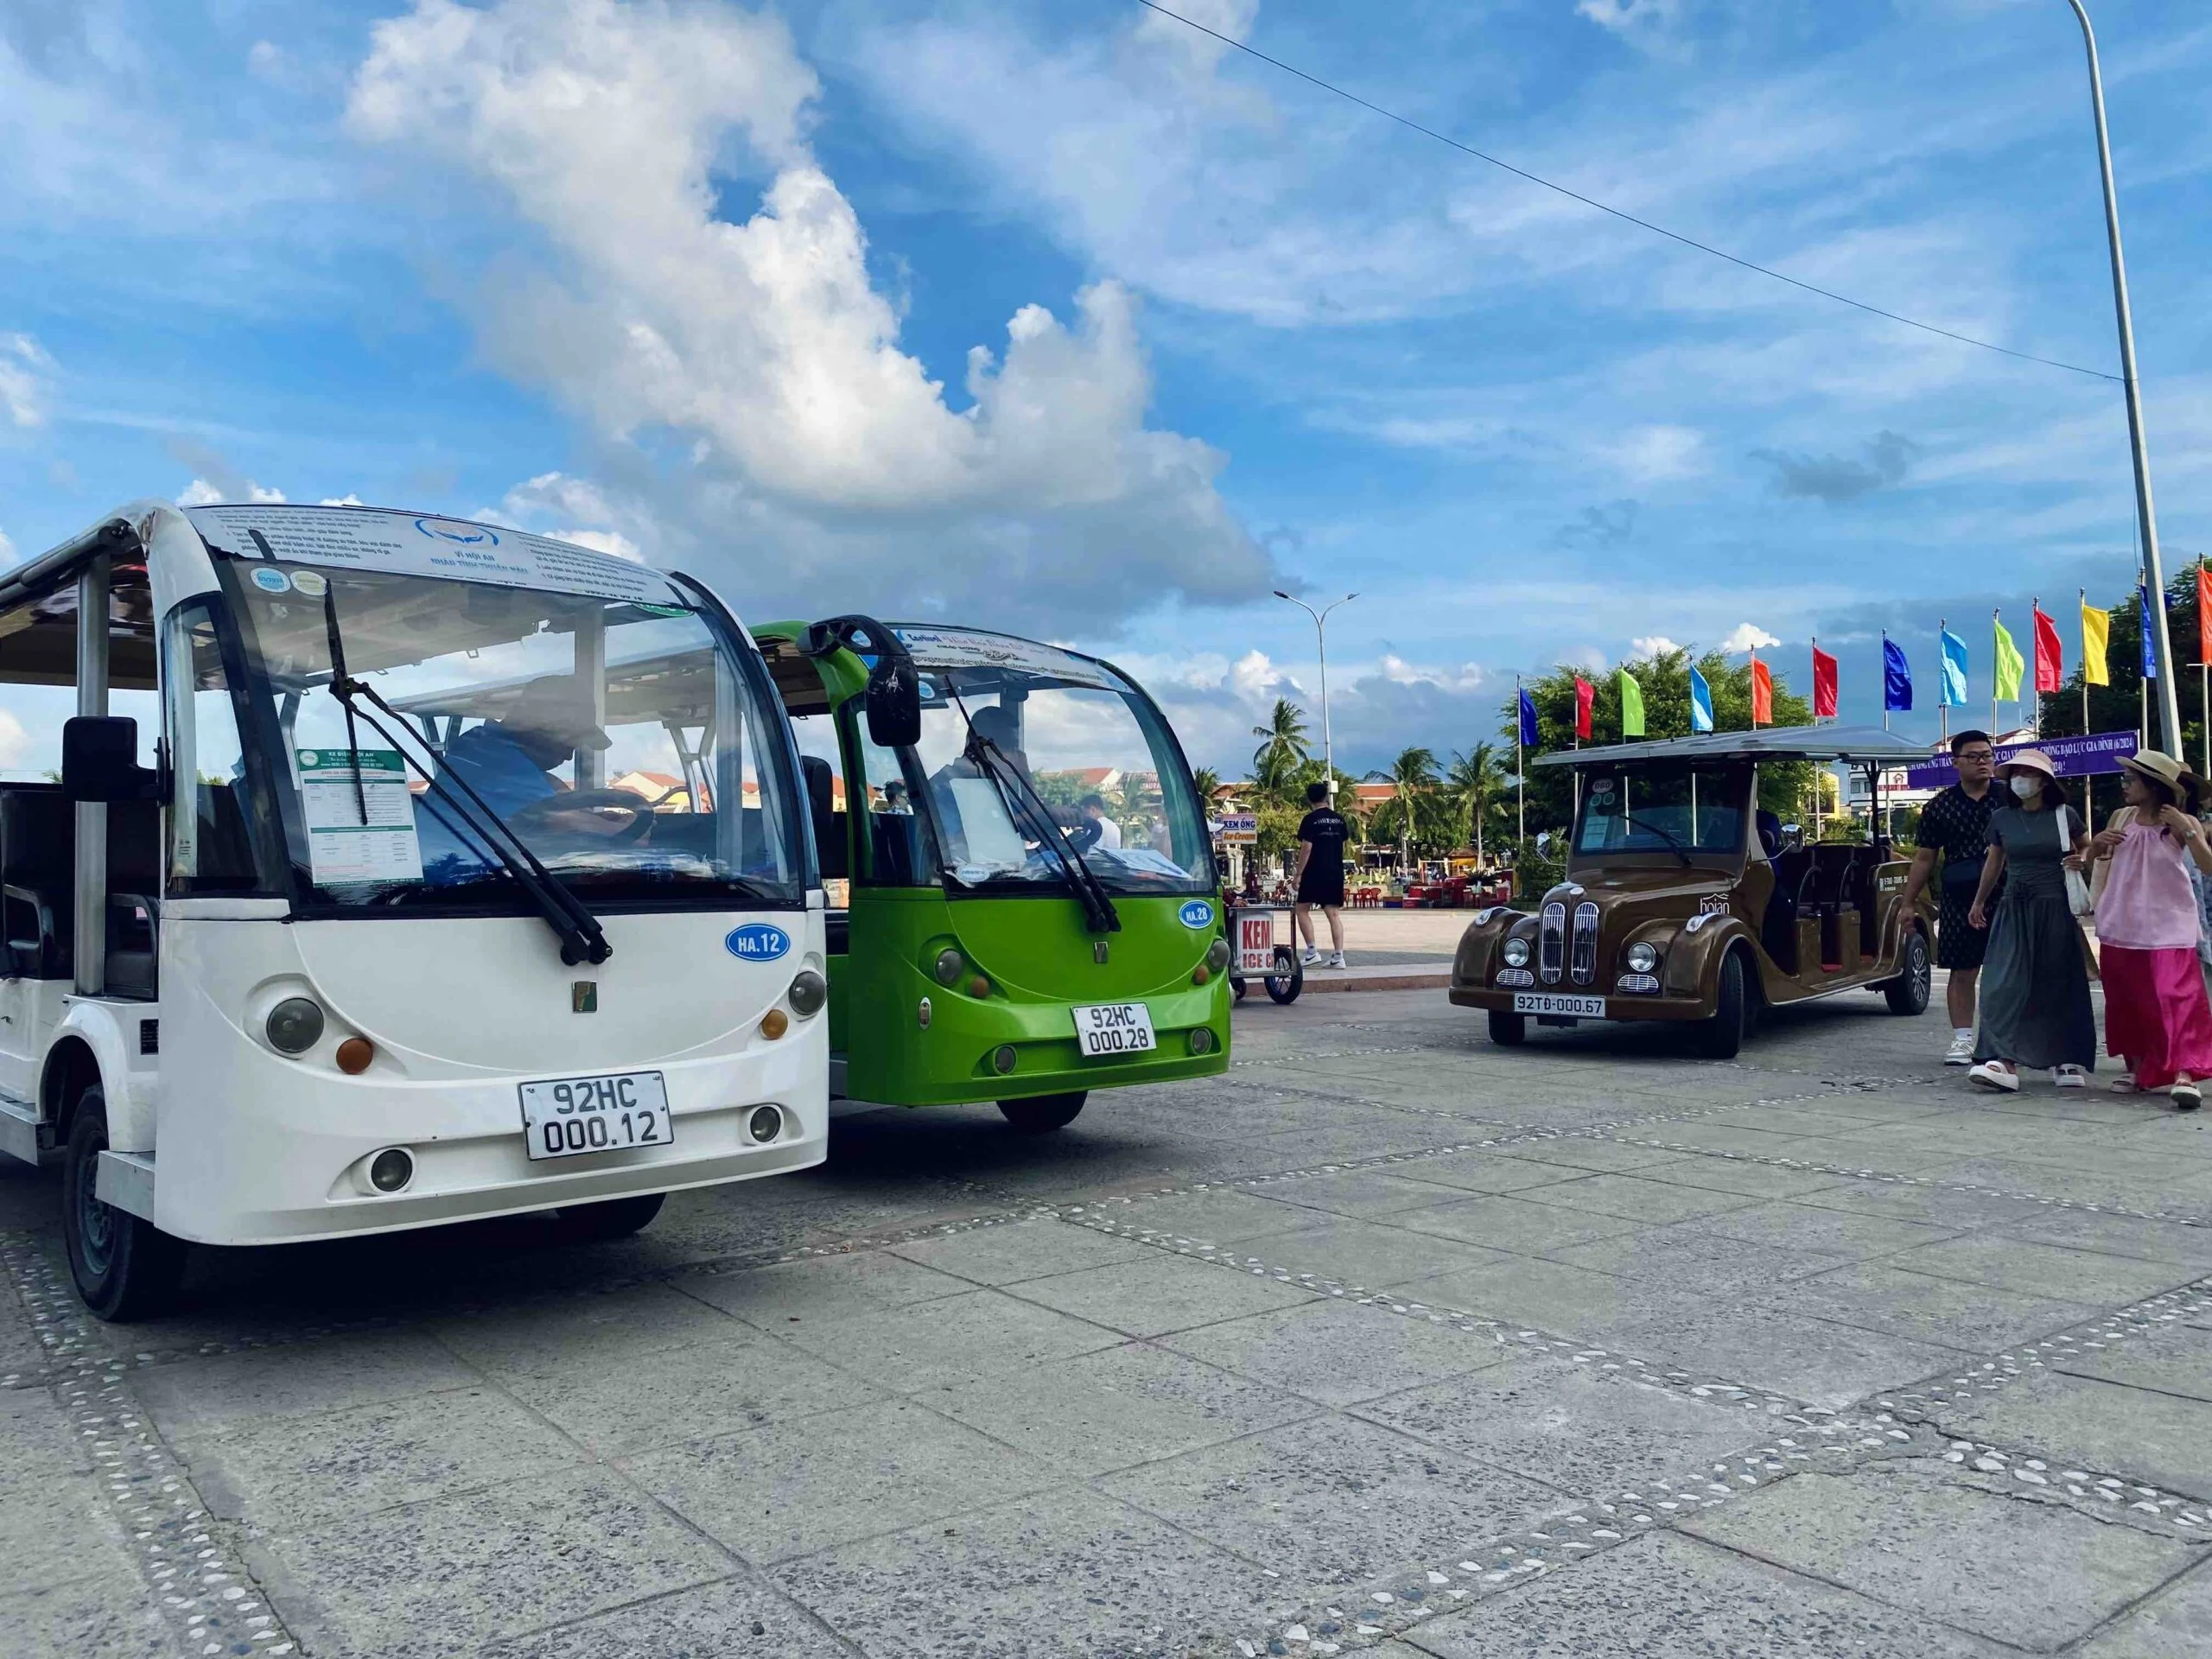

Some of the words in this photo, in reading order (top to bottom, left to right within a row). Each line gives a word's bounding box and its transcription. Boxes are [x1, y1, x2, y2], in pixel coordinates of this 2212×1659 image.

[2061, 743, 2073, 757] BẠO
[2086, 741, 2098, 752] GIA
[1185, 907, 1208, 922] HA.28
[738, 932, 779, 952] HA.12
[1243, 920, 1270, 950] KEM
[1243, 953, 1262, 968] ICE
[1090, 1006, 1135, 1028] 92HC
[1089, 1027, 1149, 1052] 000.28
[554, 1077, 638, 1115] 92HC
[543, 1110, 658, 1153] 000.12
